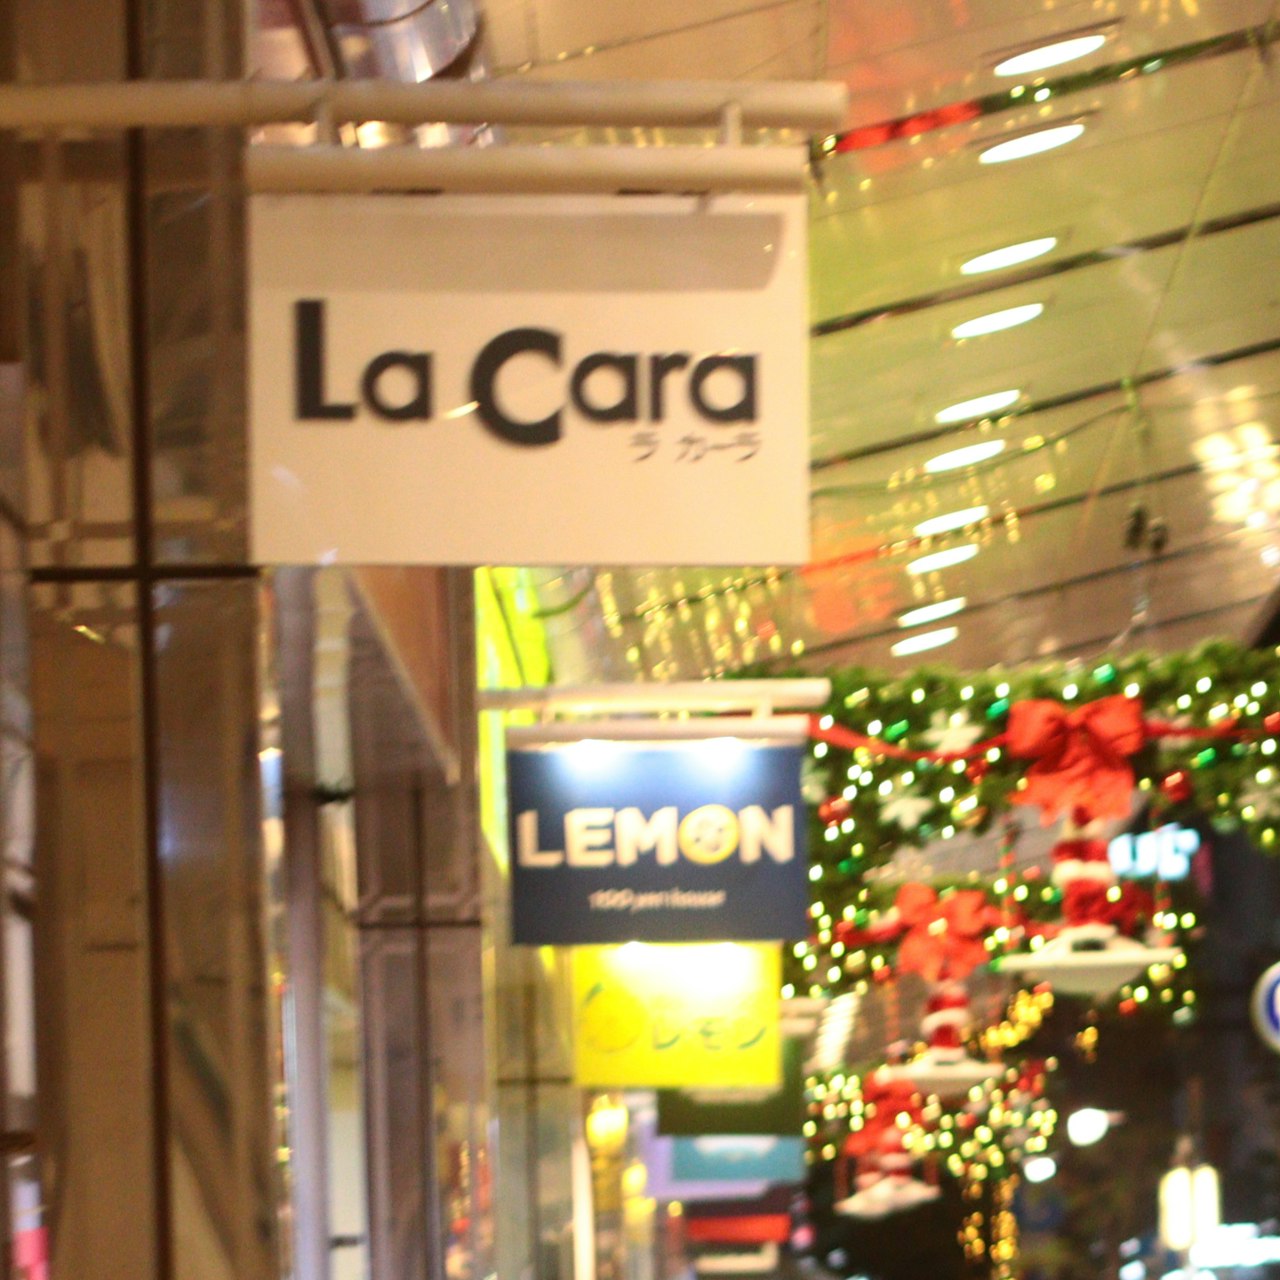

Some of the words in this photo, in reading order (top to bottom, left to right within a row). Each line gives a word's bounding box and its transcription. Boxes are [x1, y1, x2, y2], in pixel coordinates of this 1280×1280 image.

[295, 298, 435, 425] La
[470, 326, 758, 448] Cara
[628, 430, 662, 462] ラ
[671, 430, 761, 462] カーラ
[516, 803, 795, 867] LEMON
